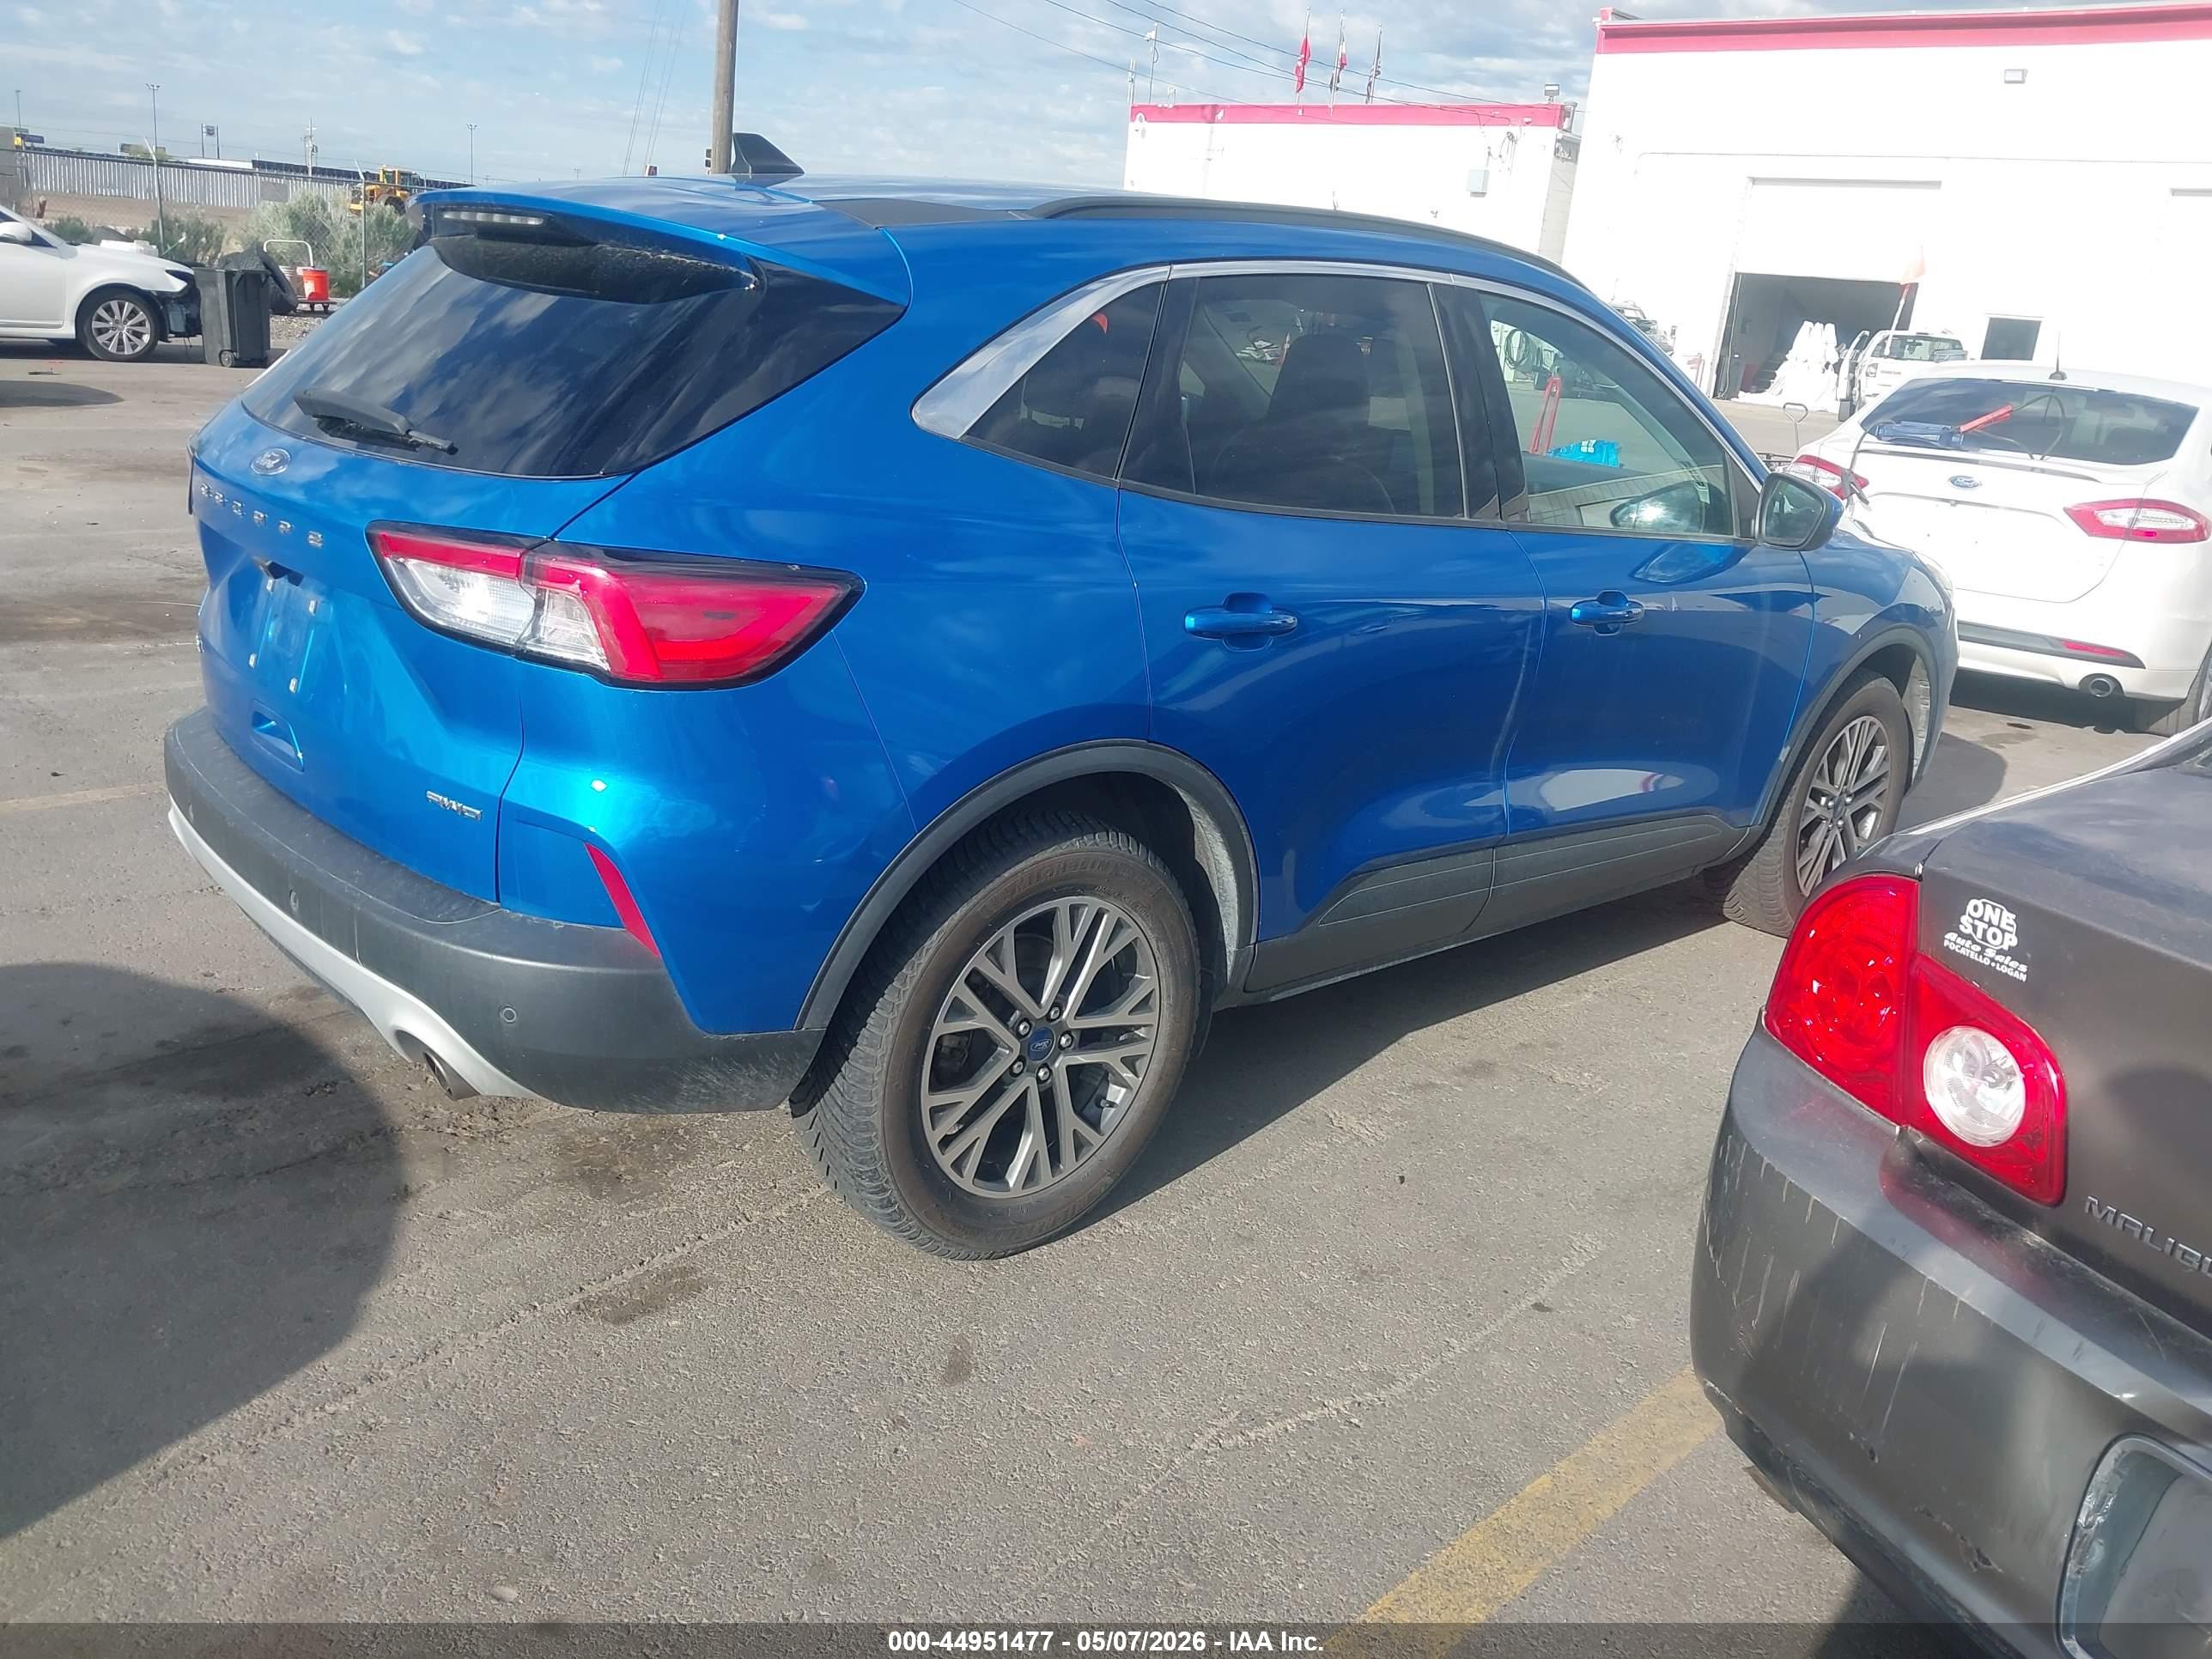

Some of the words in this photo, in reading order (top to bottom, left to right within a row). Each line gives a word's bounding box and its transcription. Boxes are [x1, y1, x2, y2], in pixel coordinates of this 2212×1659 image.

[1959, 915, 2018, 951] STOP
[1967, 899, 2016, 933] ONE
[1944, 933, 1982, 951] Auto
[1984, 948, 2027, 972] Sales
